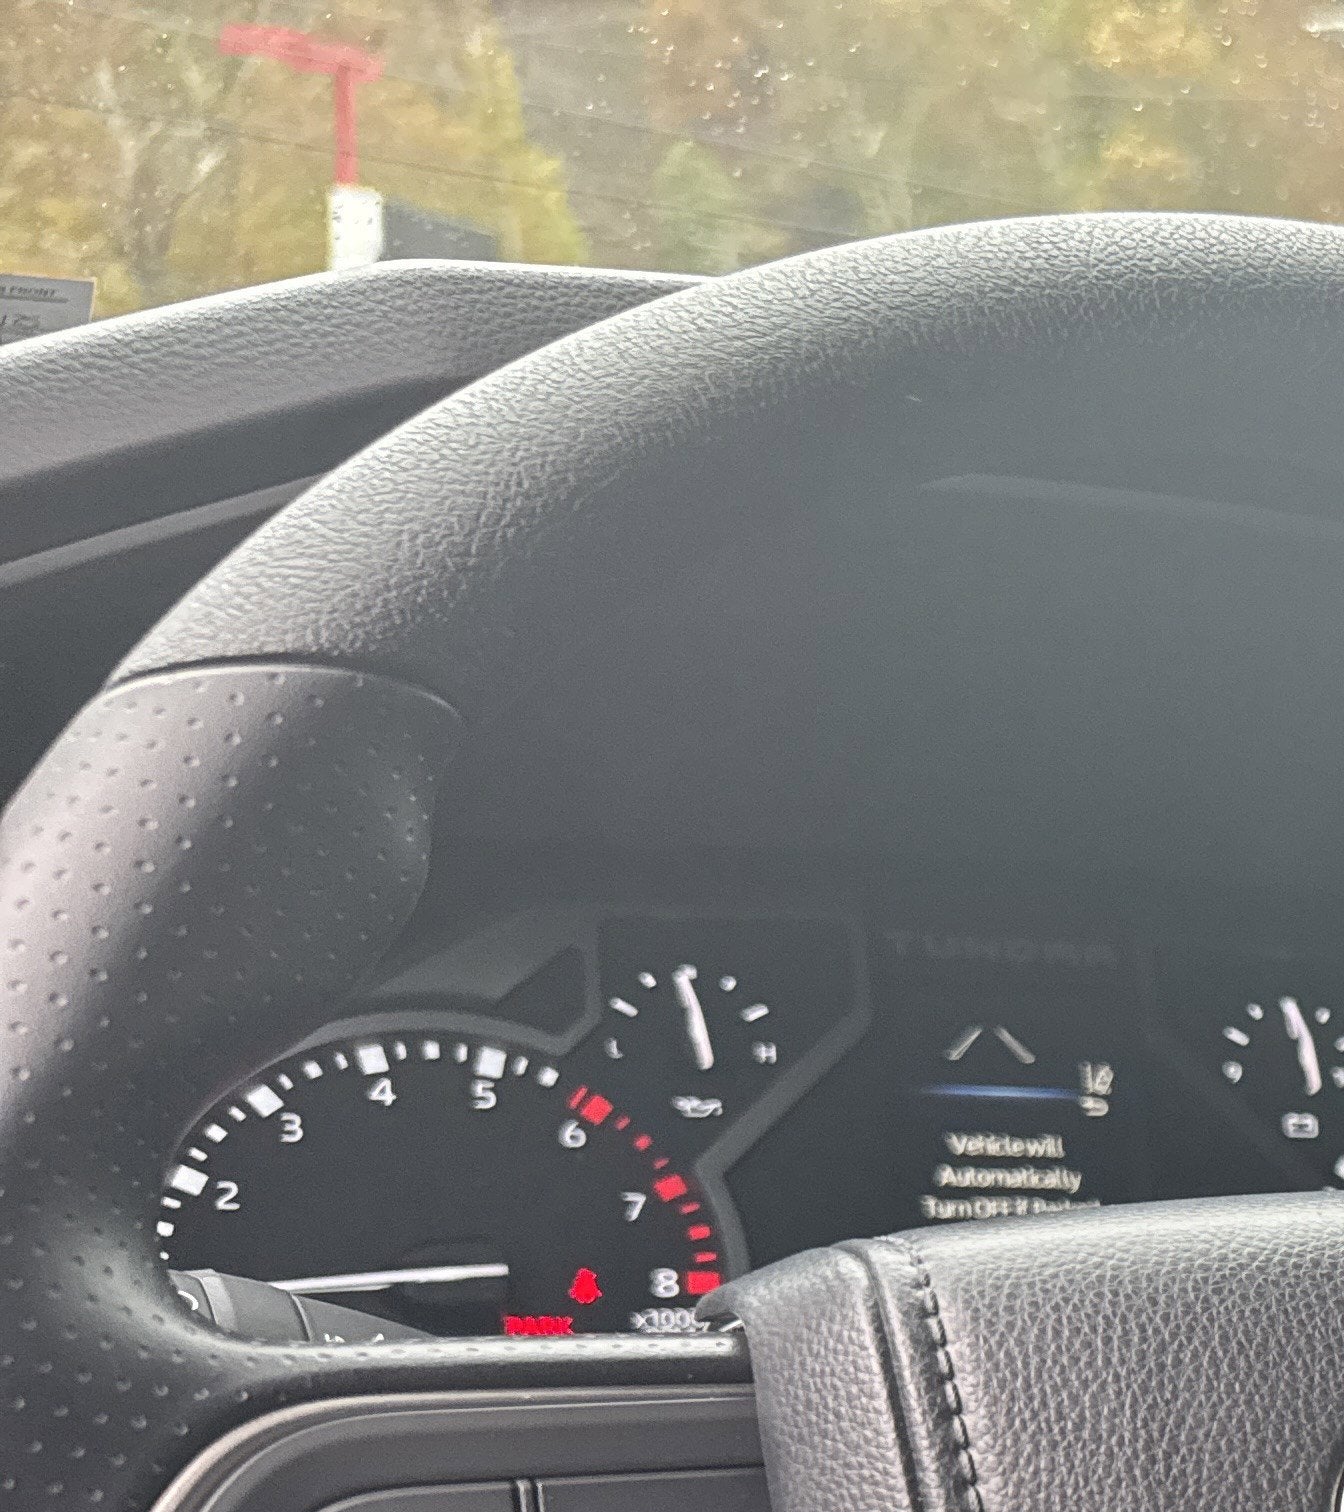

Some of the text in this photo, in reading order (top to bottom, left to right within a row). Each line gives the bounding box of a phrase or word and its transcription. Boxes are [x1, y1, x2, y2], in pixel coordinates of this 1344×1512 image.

[367, 1077, 397, 1107] 4
[471, 1079, 498, 1110] 5
[279, 1112, 304, 1143] 3
[558, 1119, 587, 1149] 6
[934, 1163, 1082, 1194] Automatically
[215, 1180, 240, 1211] 2
[621, 1191, 646, 1222] 7
[650, 1268, 680, 1298] 8
